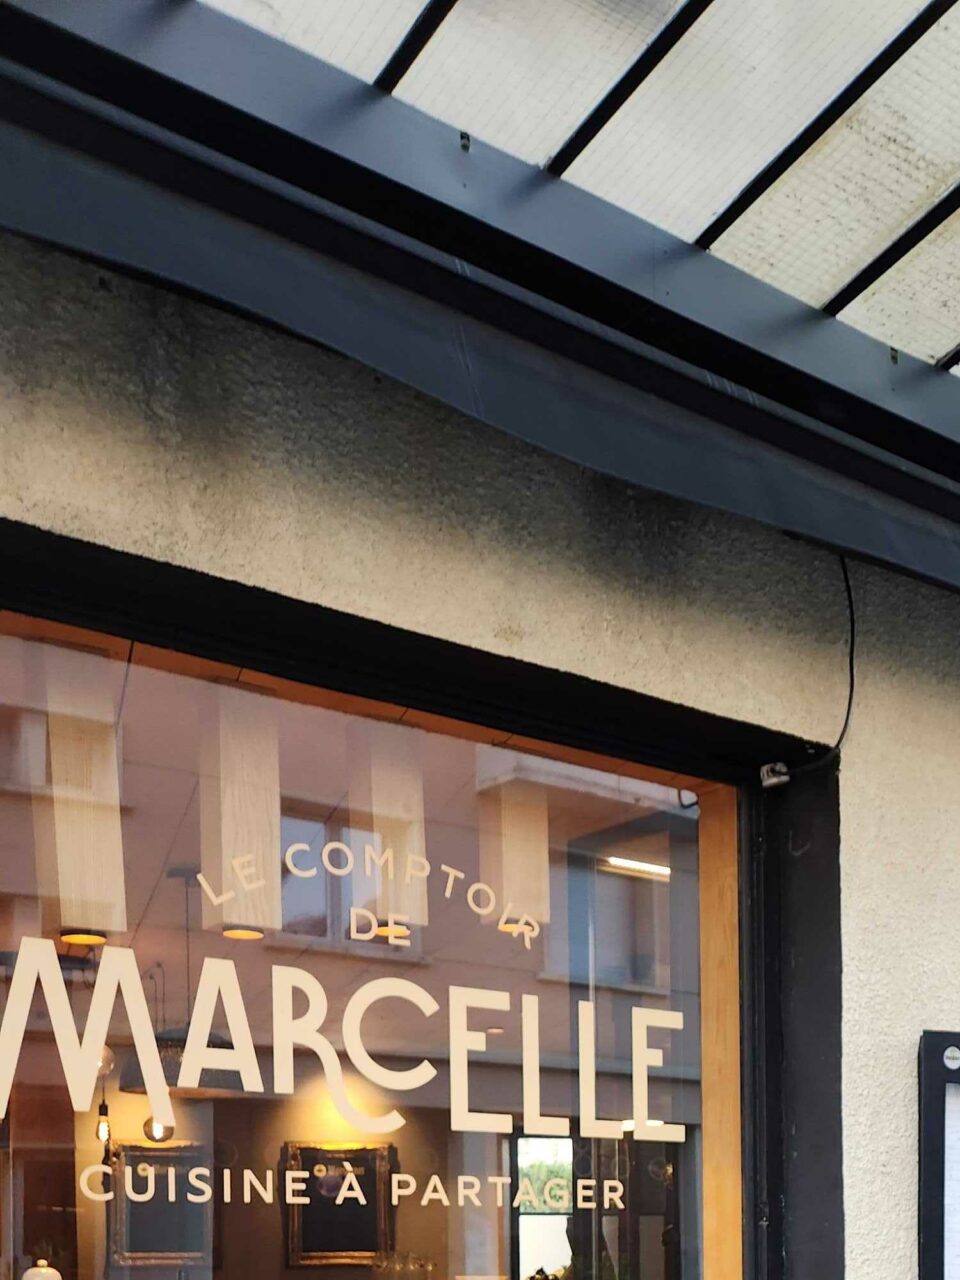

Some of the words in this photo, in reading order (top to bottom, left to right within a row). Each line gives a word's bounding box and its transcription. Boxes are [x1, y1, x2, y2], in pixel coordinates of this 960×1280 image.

[196, 854, 266, 907] LE
[284, 841, 540, 950] COMPTOIR
[350, 907, 412, 947] DE
[0, 936, 686, 1142] MARCELLE
[79, 1164, 311, 1205] CUISINE
[334, 1160, 368, 1206] À
[391, 1173, 626, 1210] PARTAGER
